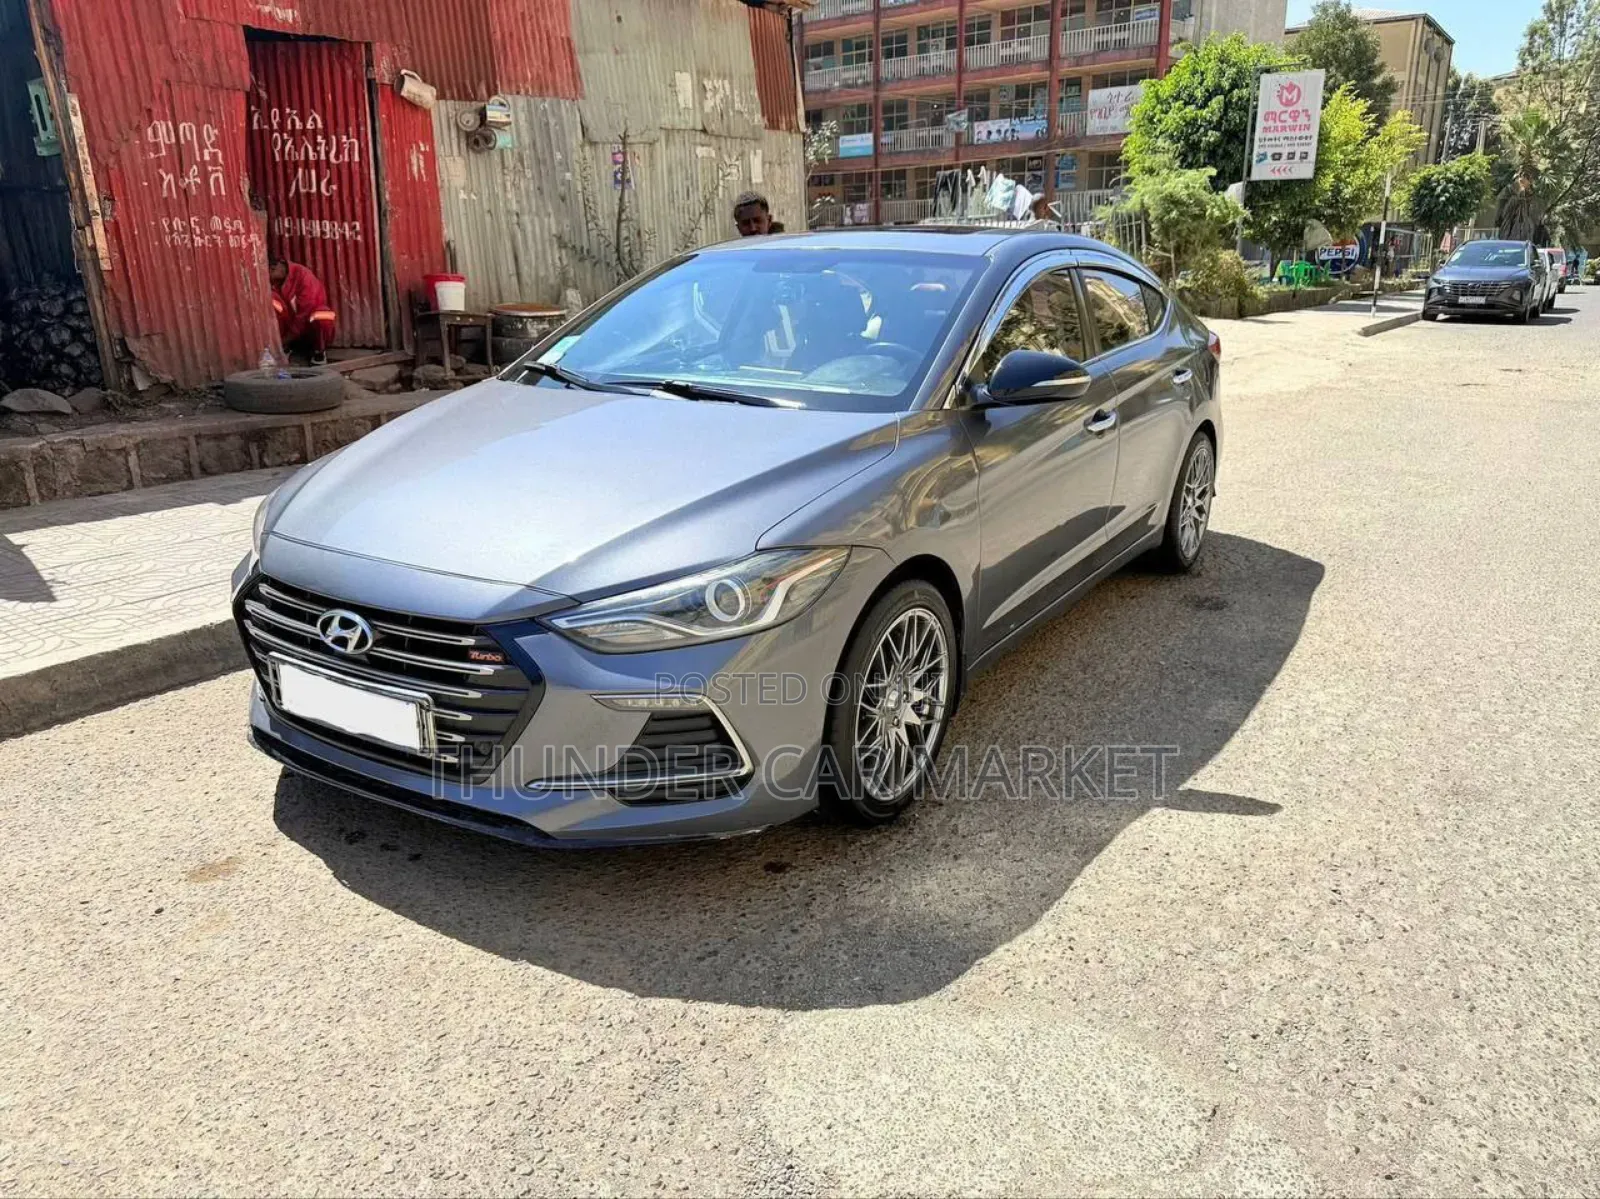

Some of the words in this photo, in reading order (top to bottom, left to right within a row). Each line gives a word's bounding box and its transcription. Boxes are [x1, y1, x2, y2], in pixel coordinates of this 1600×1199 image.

[1262, 123, 1311, 133] MARWIN
[1320, 246, 1355, 257] PEPSI
[469, 650, 503, 662] Turbo
